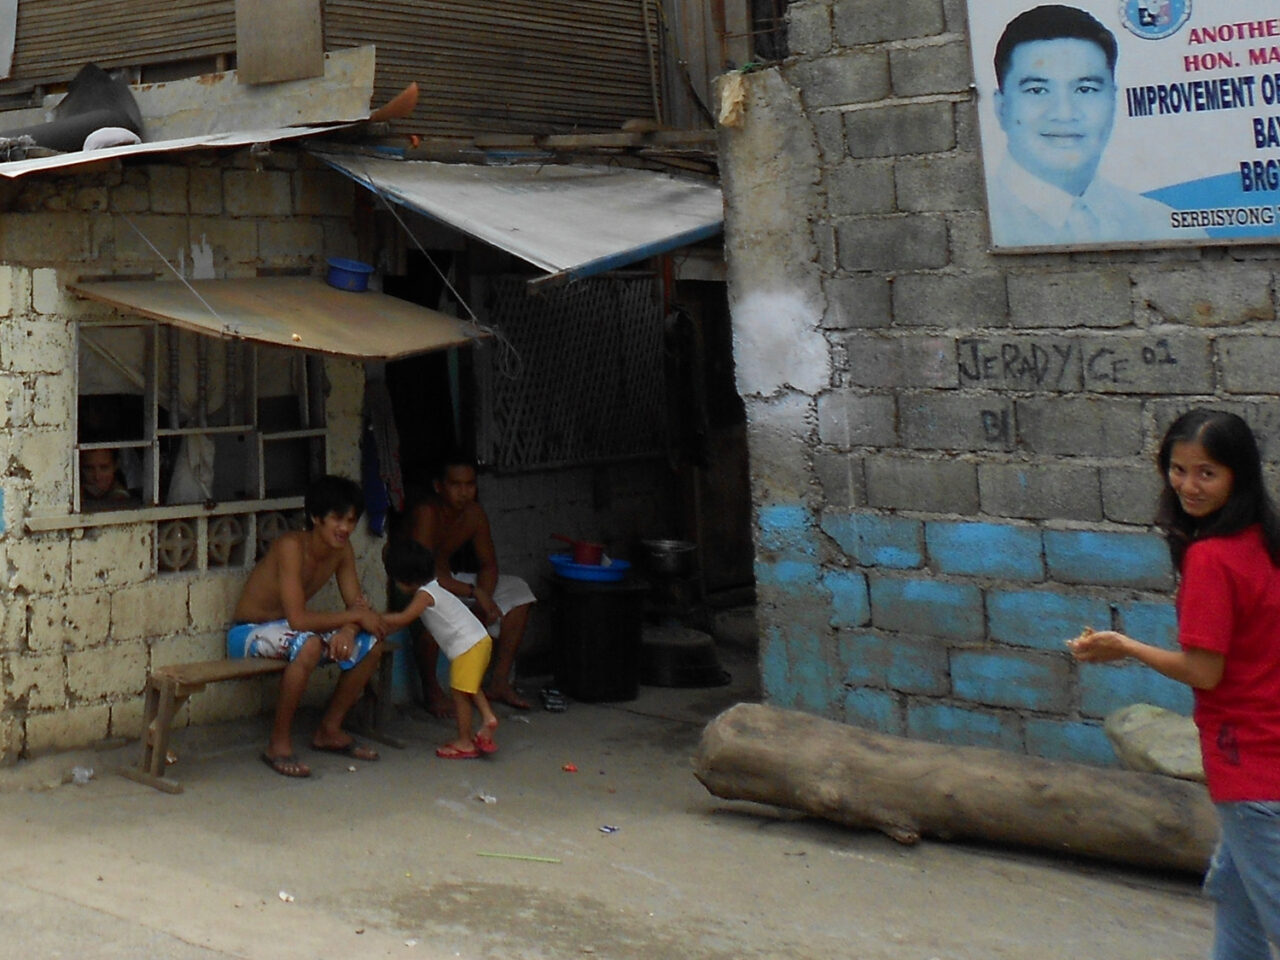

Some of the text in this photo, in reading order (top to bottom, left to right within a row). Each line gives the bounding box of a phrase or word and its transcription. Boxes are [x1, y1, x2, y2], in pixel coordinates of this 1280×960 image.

[1184, 52, 1240, 72] HON.
[1125, 76, 1255, 117] IMPROVEMENT
[1171, 207, 1274, 228] SERBISYONG
